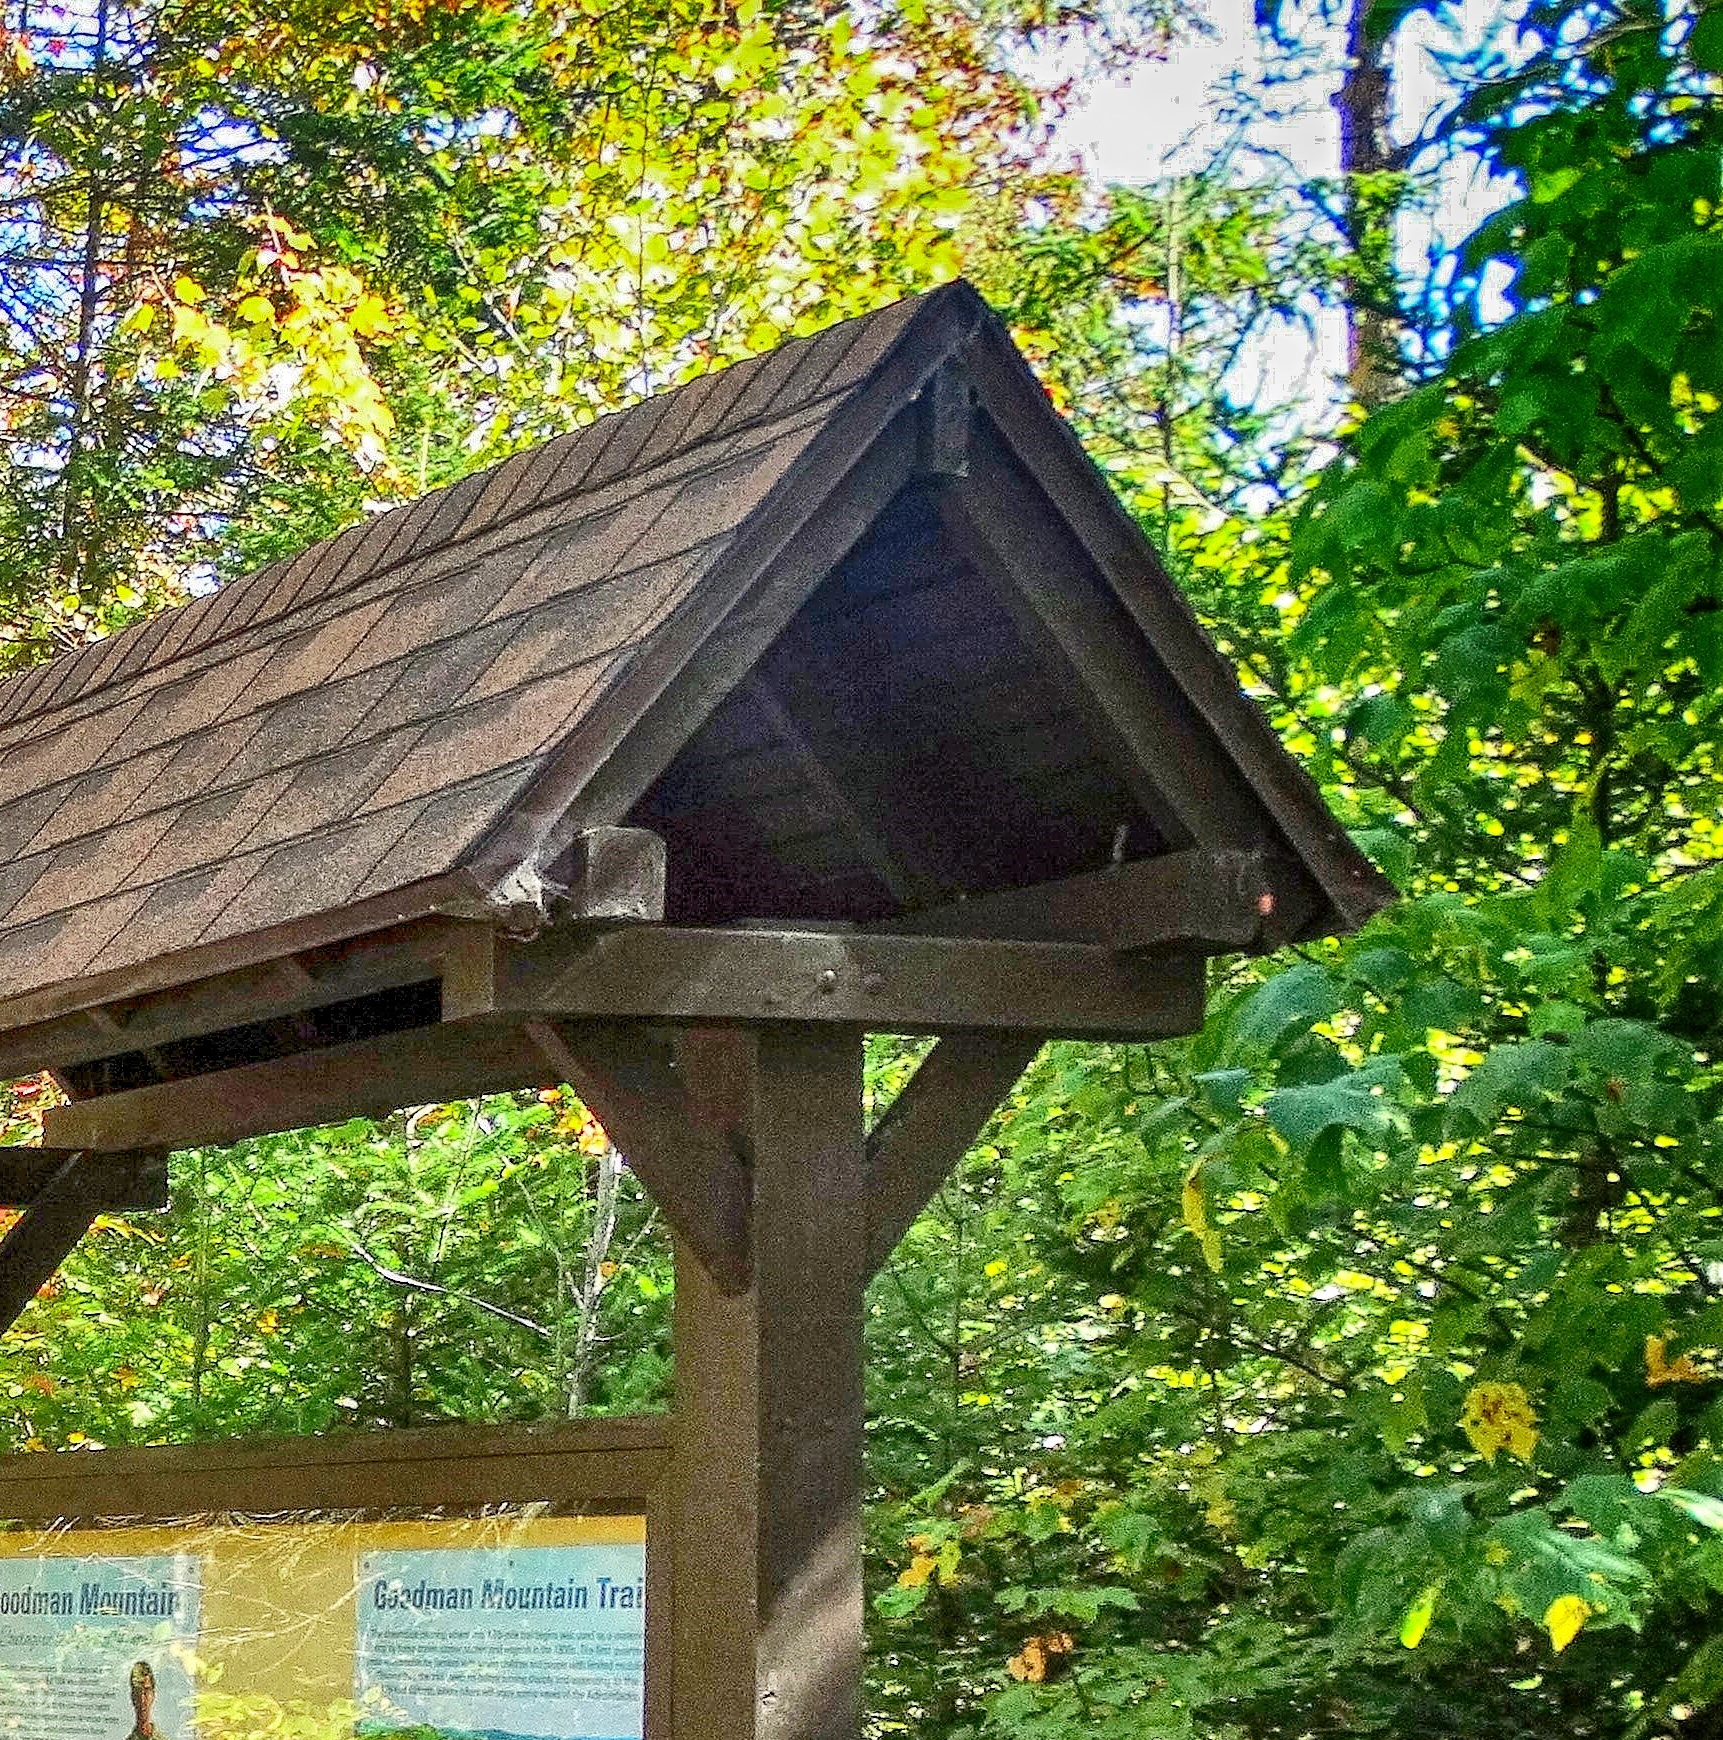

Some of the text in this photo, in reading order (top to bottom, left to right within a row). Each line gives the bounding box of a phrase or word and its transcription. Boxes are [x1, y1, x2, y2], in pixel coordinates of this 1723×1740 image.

[79, 1582, 177, 1616] Mountain
[375, 1576, 644, 1610] Goodman Mountain Trai
